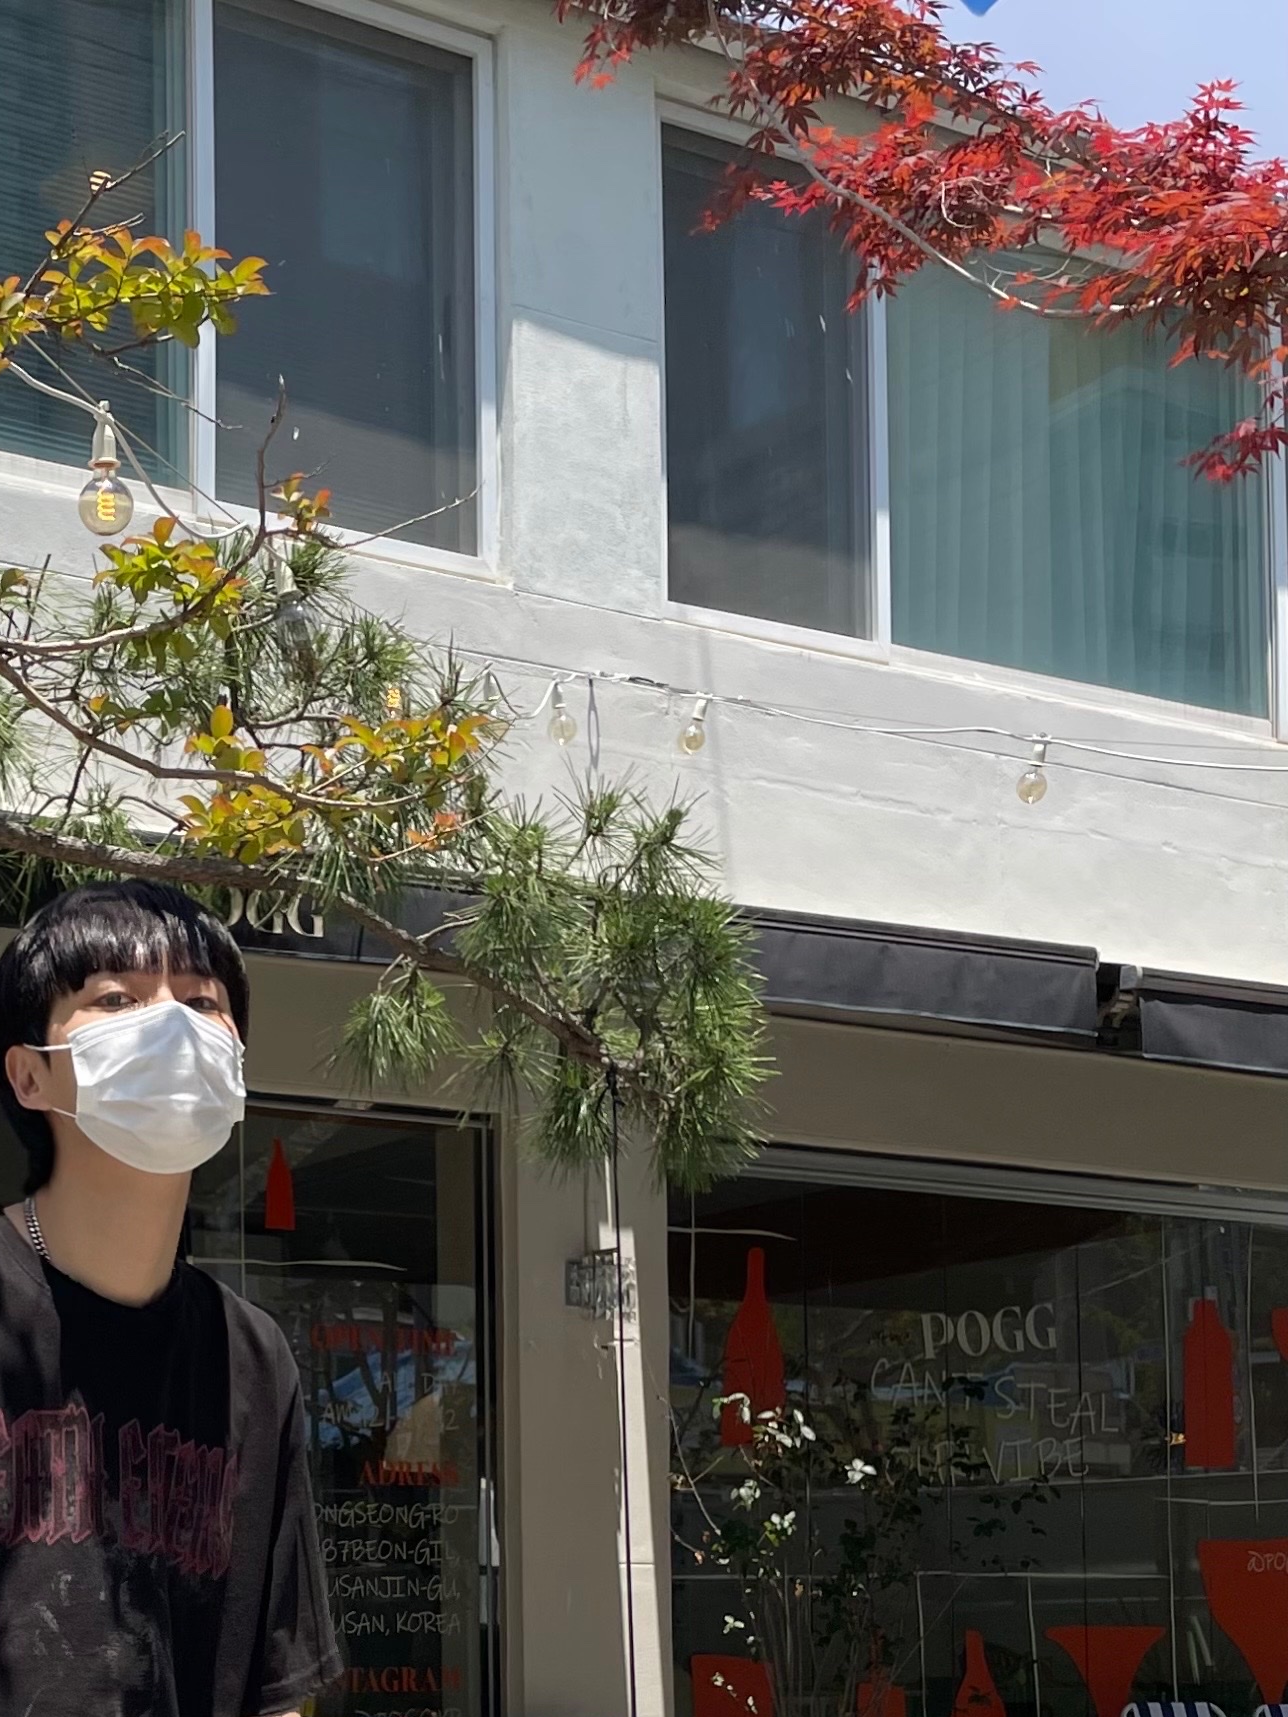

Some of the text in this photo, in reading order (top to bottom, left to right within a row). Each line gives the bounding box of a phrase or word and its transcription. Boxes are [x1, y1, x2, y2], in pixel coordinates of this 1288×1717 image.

[920, 1302, 1058, 1360] POGG
[993, 1374, 1119, 1435] STEAL
[981, 1434, 1089, 1484] VIBE
[312, 1501, 459, 1529] ONGSEONG-RO
[396, 1611, 461, 1636] KOREA
